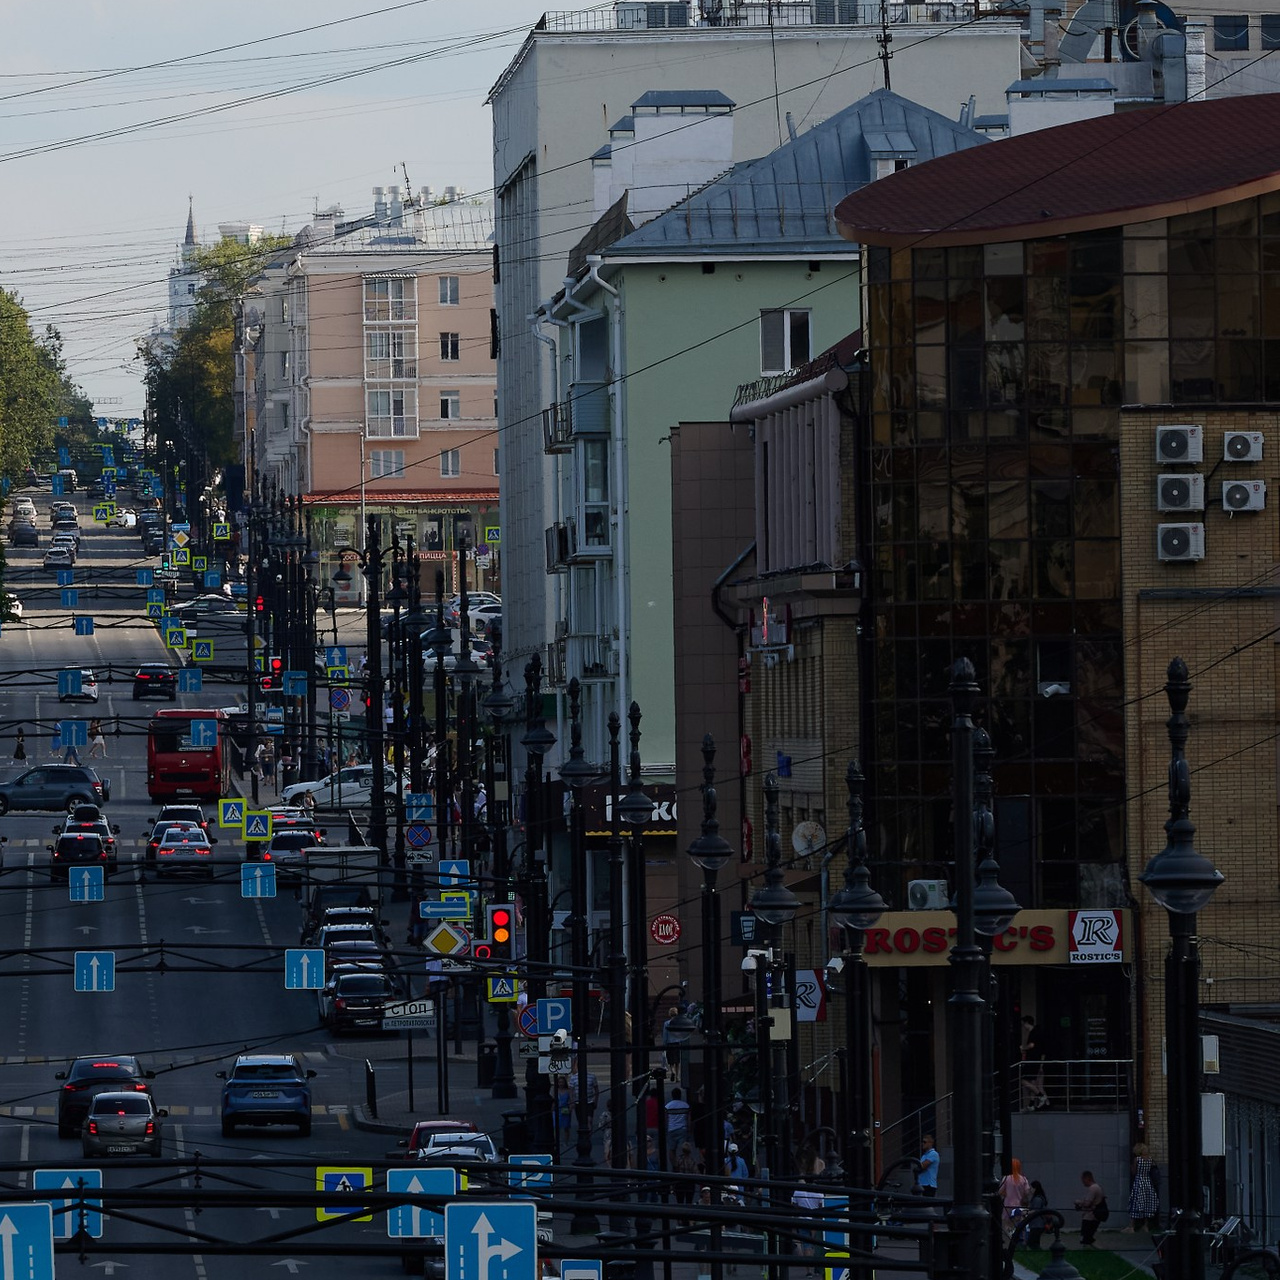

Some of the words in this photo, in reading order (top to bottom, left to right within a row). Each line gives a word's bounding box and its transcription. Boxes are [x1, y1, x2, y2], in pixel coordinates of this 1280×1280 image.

[420, 552, 447, 560] ПИЦЦА
[864, 925, 1055, 954] ROSC'S
[1072, 952, 1120, 961] ROSTIC'S
[391, 1003, 427, 1015] СТОП
[547, 1002, 565, 1030] P
